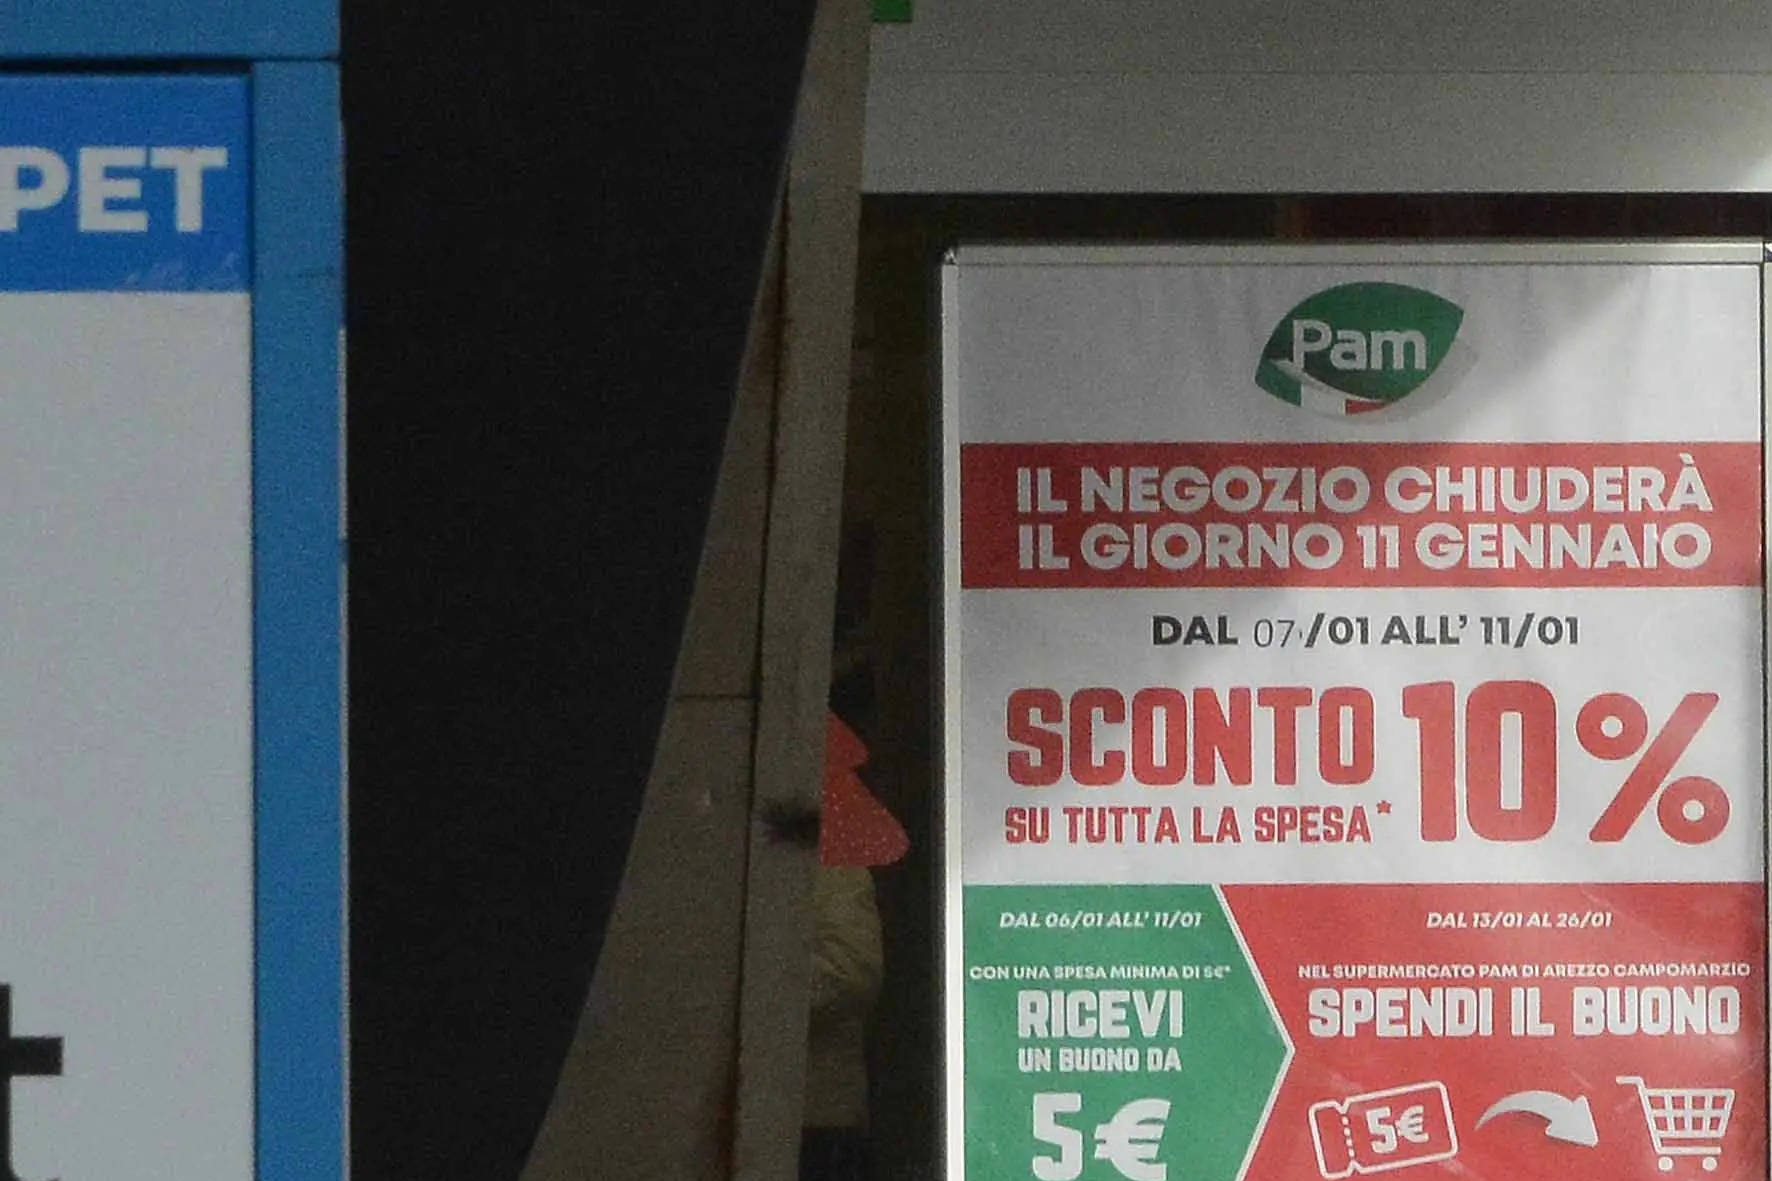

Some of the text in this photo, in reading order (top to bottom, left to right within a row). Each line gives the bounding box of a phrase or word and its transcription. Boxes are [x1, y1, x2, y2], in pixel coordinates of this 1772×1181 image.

[0, 147, 228, 232] PET
[1289, 319, 1428, 373] Pam
[1016, 452, 1714, 514] IL NEGOZIO CHIUDERÀ
[1018, 521, 1712, 571] IL GIORNO 11 GENNAIO
[1152, 614, 1239, 646] DAL
[1479, 612, 1579, 649] 11/01
[1006, 679, 1731, 846] SCONTO 10%
[1004, 806, 1050, 845] SU
[1062, 805, 1180, 845] TUTTA
[1192, 806, 1242, 844] LA
[999, 911, 1041, 929] DAL
[1044, 910, 1104, 930] 06/01
[1154, 909, 1202, 929] 11/01
[1426, 909, 1612, 930] DAL 13/01 AL 26/01
[969, 965, 1010, 981] CON
[1013, 965, 1051, 980] UNA
[1053, 965, 1108, 980] SPESA
[1109, 964, 1180, 980] MINIMA
[1181, 965, 1200, 980] DI
[1298, 961, 1750, 980] NEL SUPERMERCATO PAM DI AREZZO CAMPOMARZIO
[1017, 989, 1183, 1039] RICEVI
[1308, 985, 1740, 1038] SPENDI IL BUONO
[1018, 1046, 1182, 1073] UN BUONO DA
[1365, 1105, 1430, 1154] 5€
